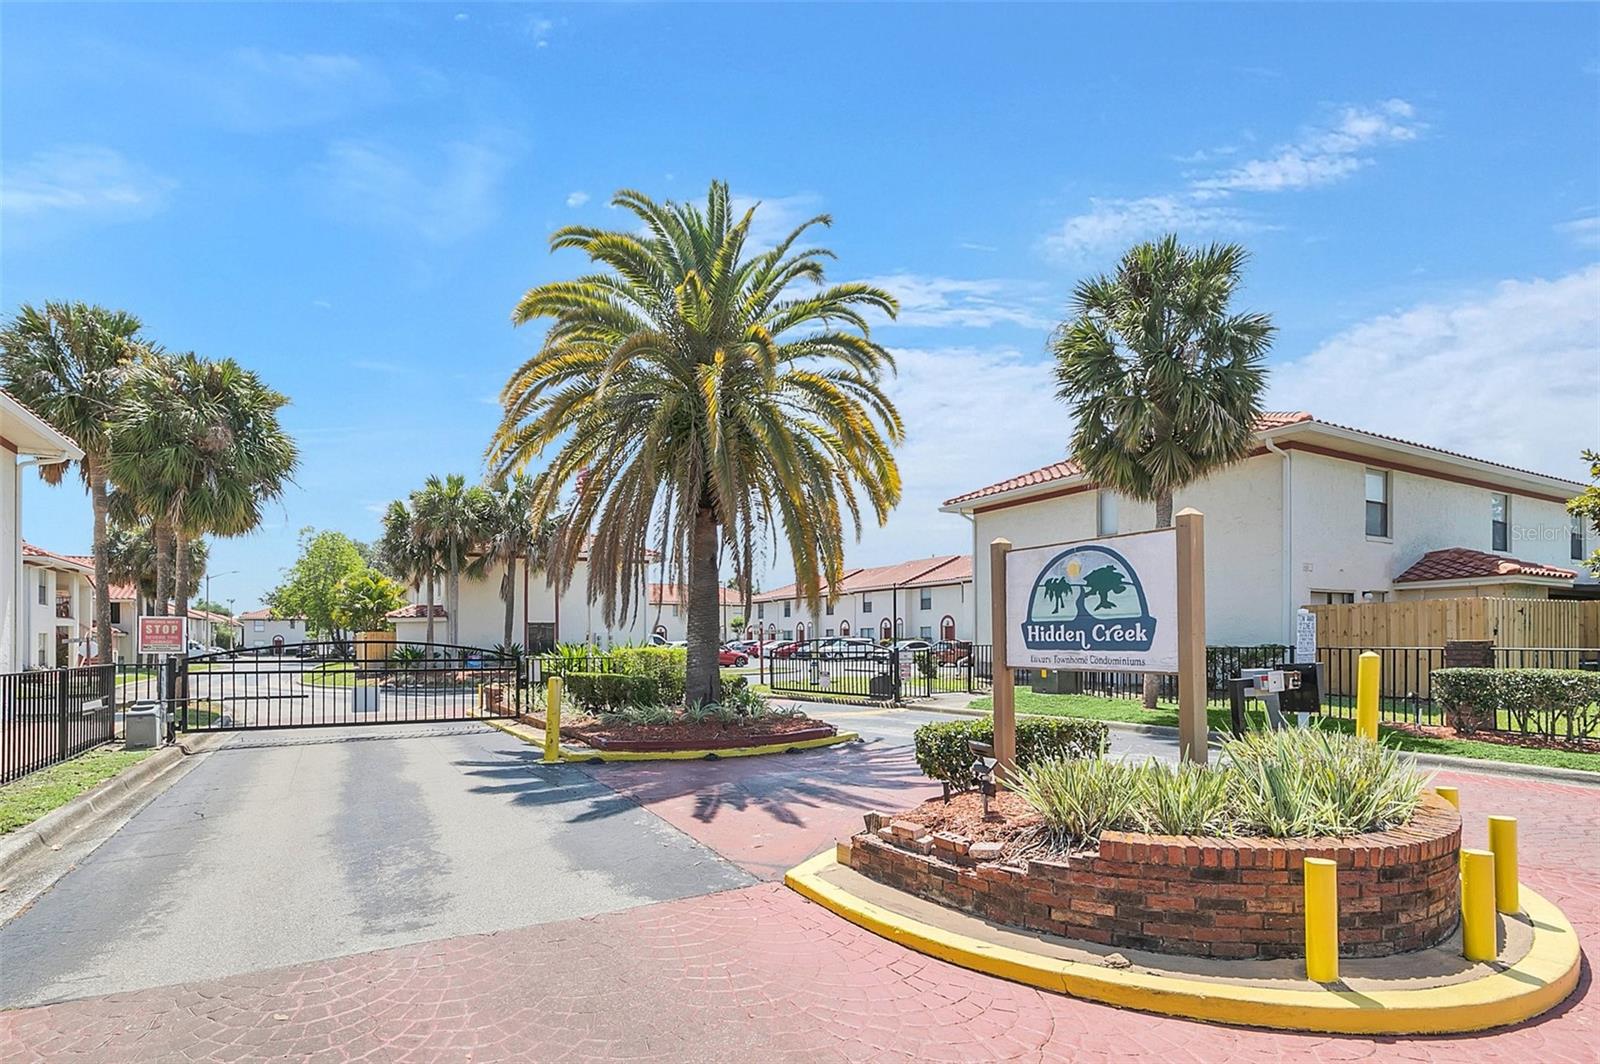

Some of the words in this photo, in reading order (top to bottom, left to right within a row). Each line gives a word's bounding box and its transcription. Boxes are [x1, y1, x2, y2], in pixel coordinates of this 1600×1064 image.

[145, 624, 178, 635] STOP
[1027, 624, 1091, 650] Hidden
[1092, 623, 1148, 642] Creek
[1089, 655, 1146, 667] Condominiums
